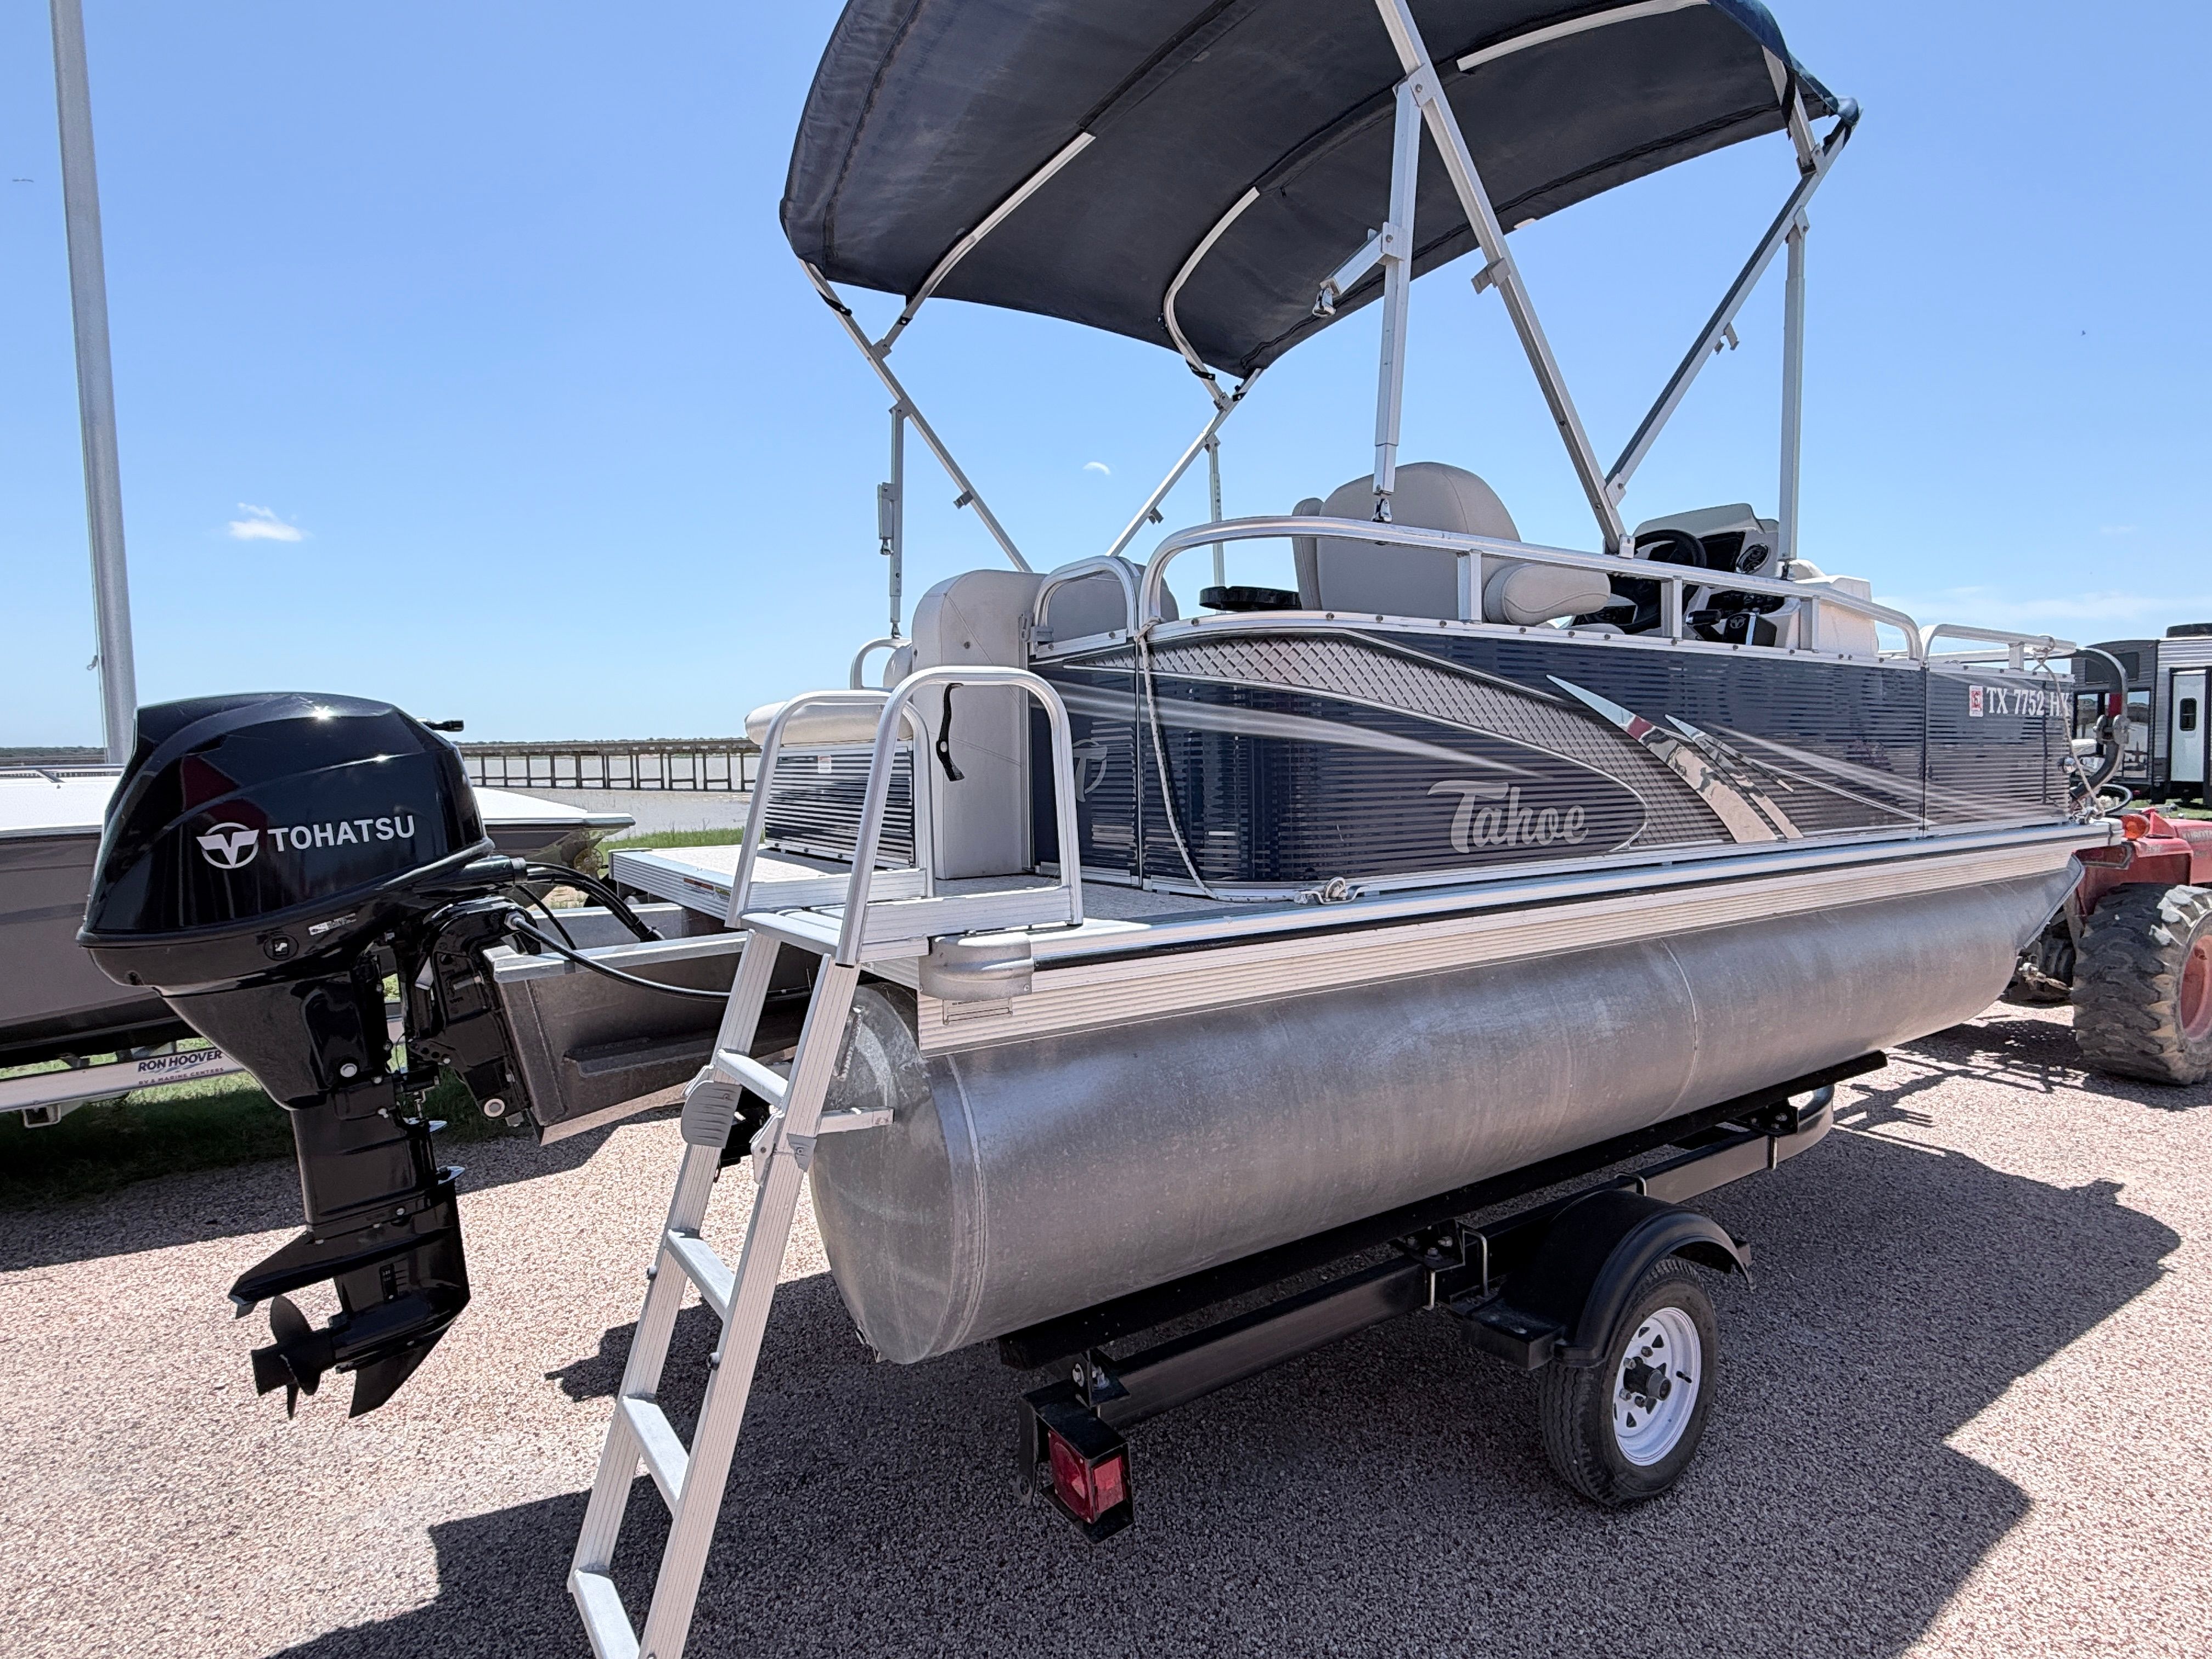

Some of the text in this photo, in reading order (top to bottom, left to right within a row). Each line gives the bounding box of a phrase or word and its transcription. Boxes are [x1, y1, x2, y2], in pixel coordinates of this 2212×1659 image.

[1986, 687, 2008, 714] TX
[2013, 689, 2045, 716] 7752
[1427, 780, 1589, 854] Tahoe
[267, 815, 415, 852] TOHATSU
[138, 1049, 223, 1072] RON HOOVER
[158, 1073, 188, 1081] MARINE
[190, 1067, 224, 1076] CENTERS
